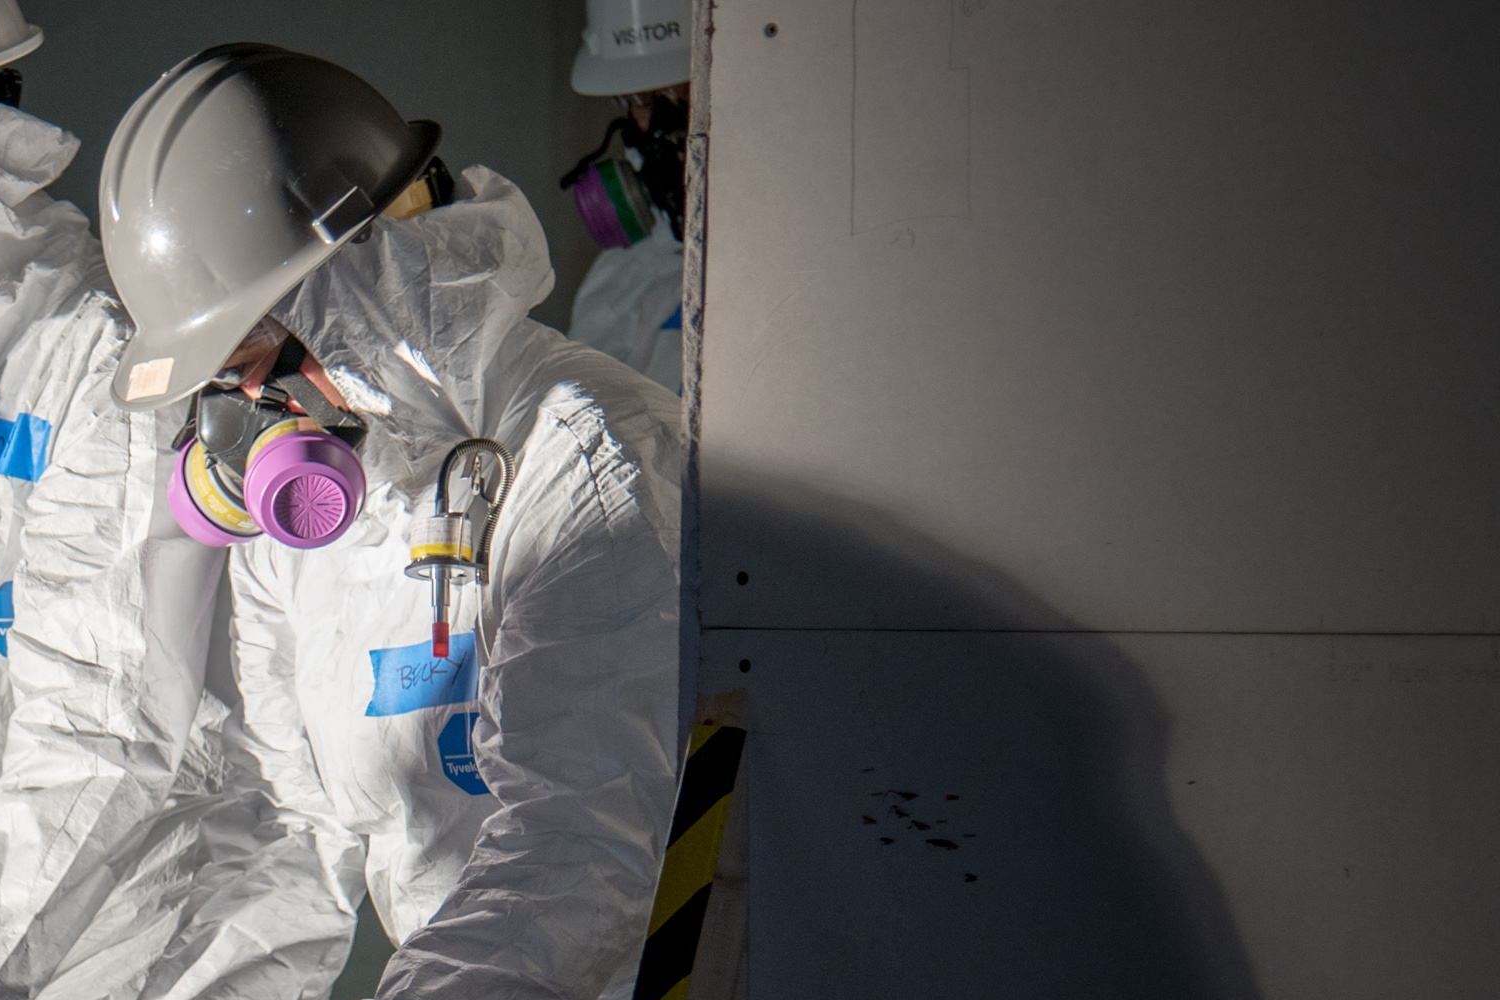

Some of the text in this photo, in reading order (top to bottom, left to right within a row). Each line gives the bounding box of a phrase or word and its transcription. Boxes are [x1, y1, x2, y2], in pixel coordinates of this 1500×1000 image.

[612, 21, 681, 46] VISITOR
[397, 651, 467, 690] BECKY
[446, 761, 478, 776] Tyvek
